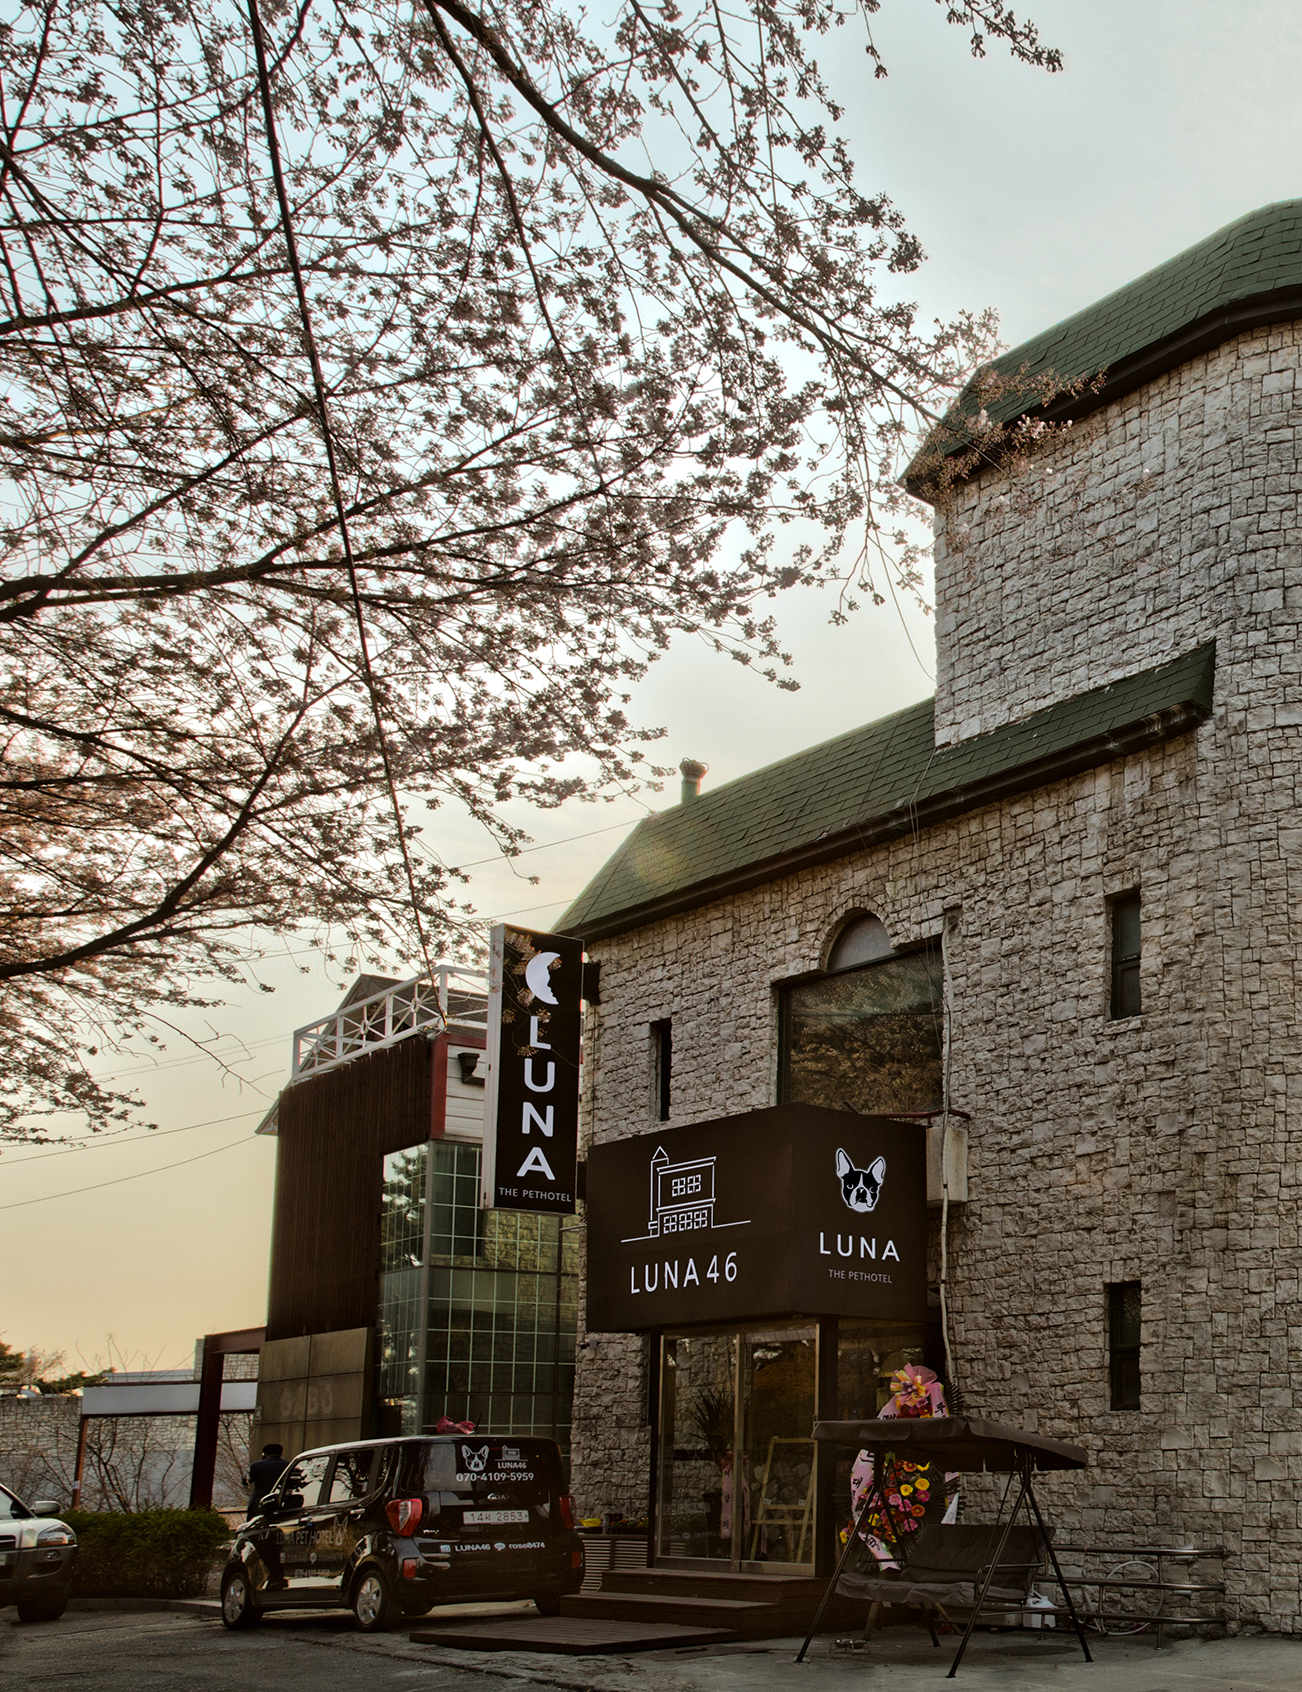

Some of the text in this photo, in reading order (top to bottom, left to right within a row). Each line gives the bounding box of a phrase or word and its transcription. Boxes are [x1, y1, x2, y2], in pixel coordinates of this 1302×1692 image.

[516, 1015, 556, 1181] LUNA
[499, 1186, 572, 1203] THE PETHOTEL
[819, 1231, 900, 1262] LUNA
[828, 1268, 893, 1284] THE PETHOTEL
[456, 1472, 535, 1482] 070-4109-5959
[496, 1511, 524, 1522] 2853
[295, 1530, 309, 1545] PET
[309, 1529, 334, 1545] HOTEL
[455, 1544, 491, 1552] LUNA46
